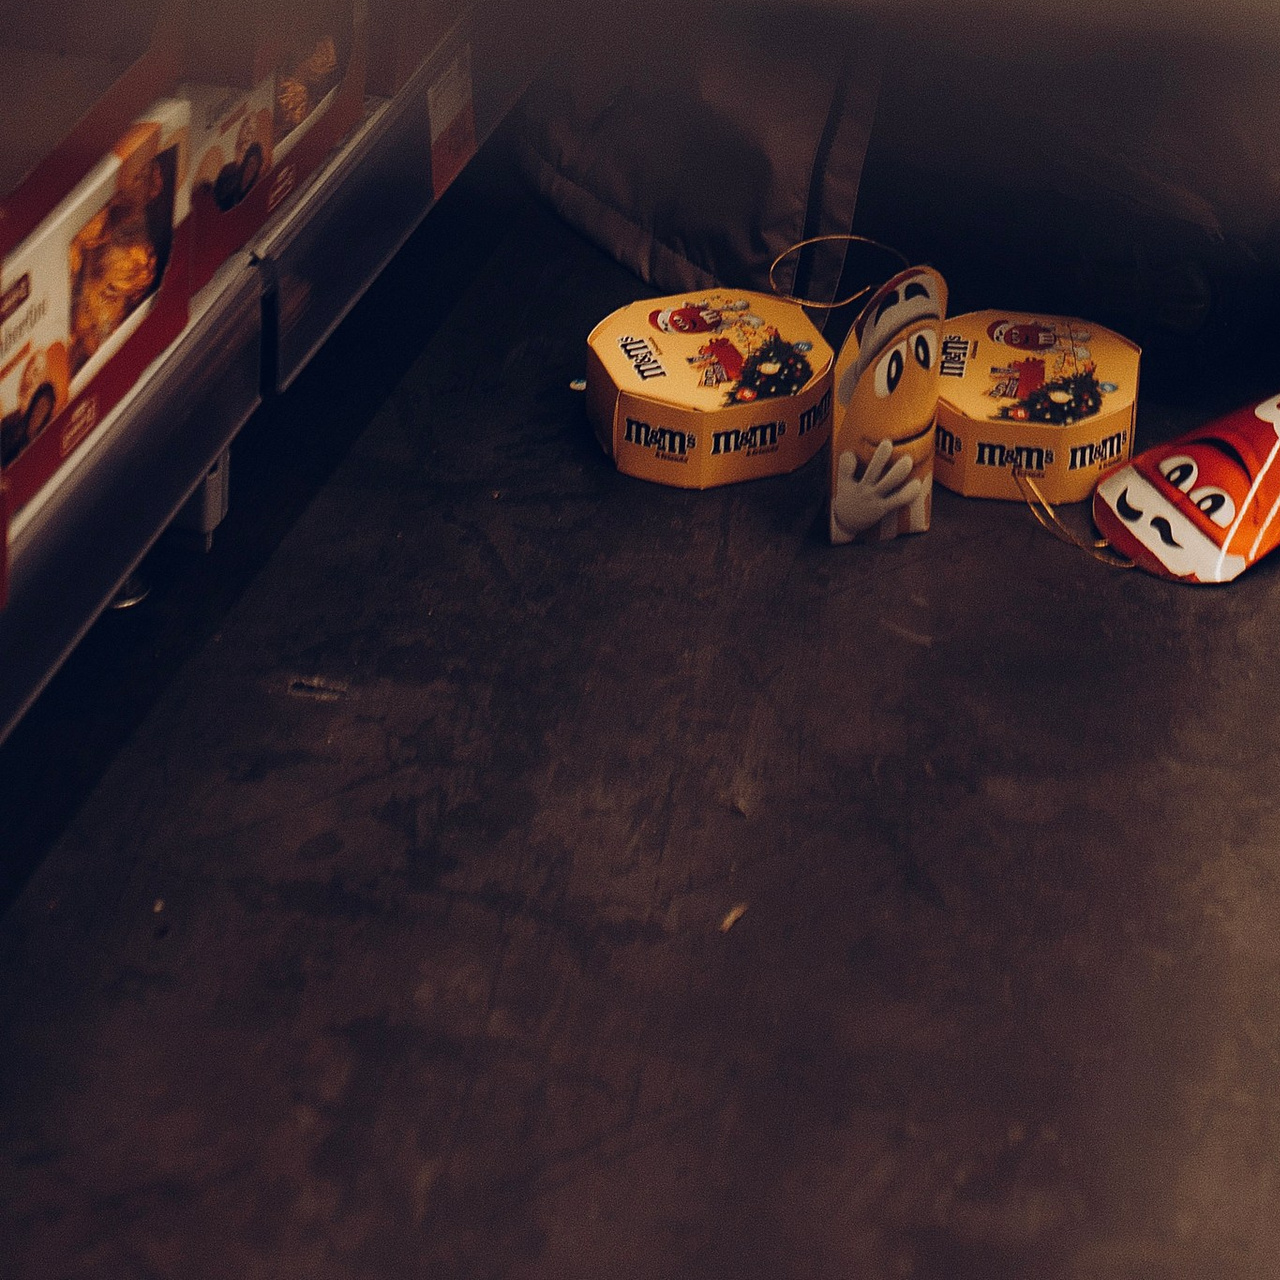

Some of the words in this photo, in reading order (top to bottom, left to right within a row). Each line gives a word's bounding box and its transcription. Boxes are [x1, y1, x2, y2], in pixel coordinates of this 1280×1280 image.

[625, 418, 697, 456] m&m's
[711, 421, 786, 456] m&m's
[1068, 430, 1127, 471] m&m's
[975, 440, 1054, 471] m&m's
